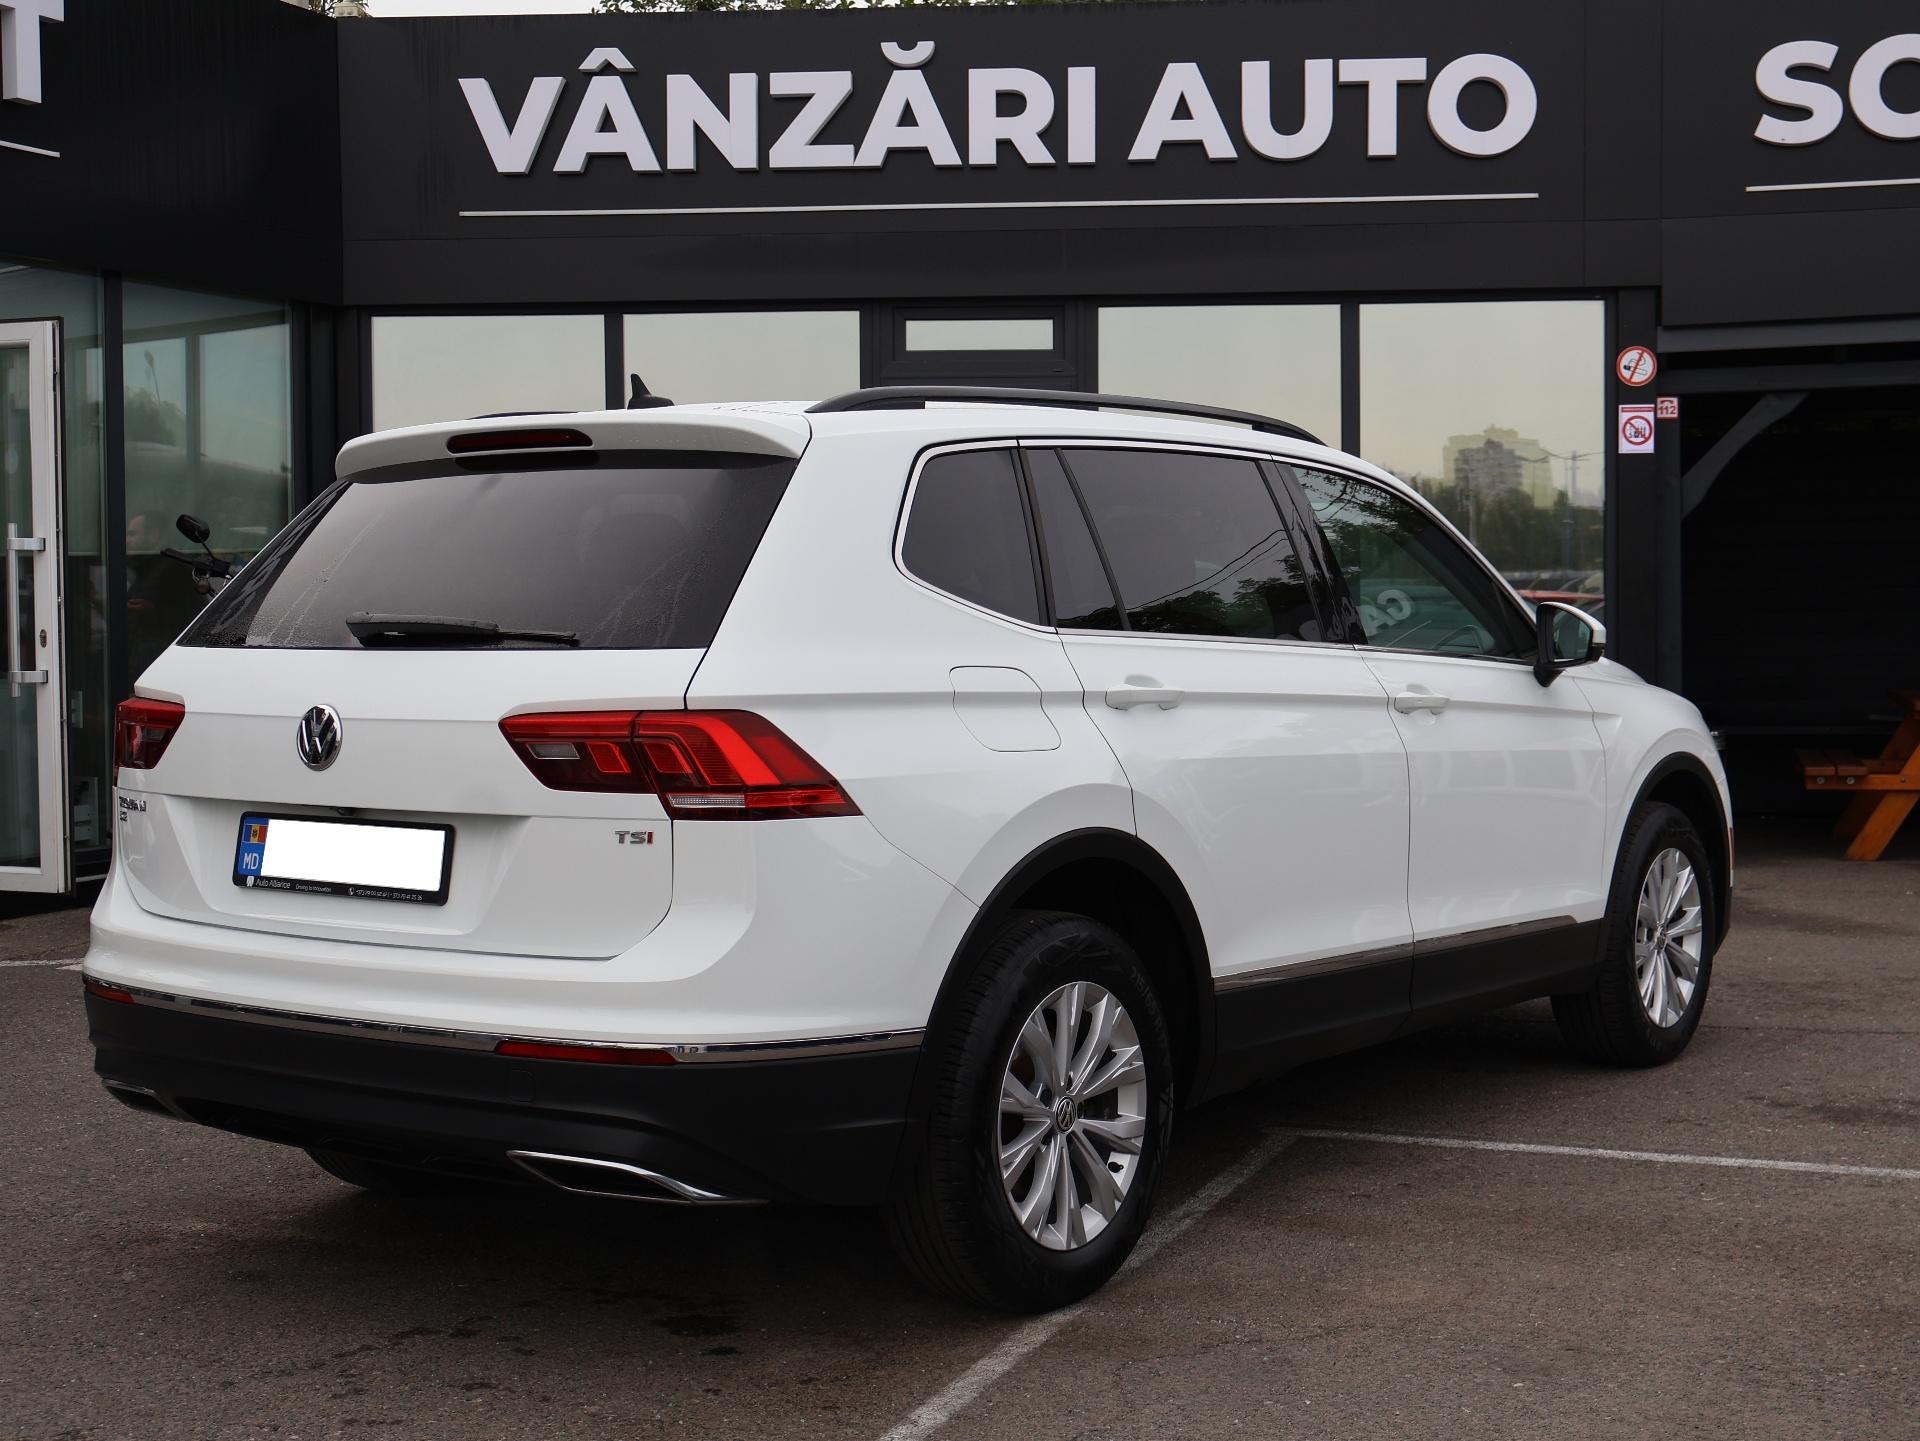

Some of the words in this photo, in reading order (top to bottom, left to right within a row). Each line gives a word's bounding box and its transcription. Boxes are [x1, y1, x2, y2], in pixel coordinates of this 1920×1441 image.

[458, 40, 1097, 175] VÂNZĂRI
[1127, 52, 1538, 162] AUTO
[1658, 406, 1677, 415] 112
[614, 830, 654, 845] TSI
[243, 852, 259, 869] MD
[256, 878, 268, 887] Auto
[269, 879, 291, 889] Alliance
